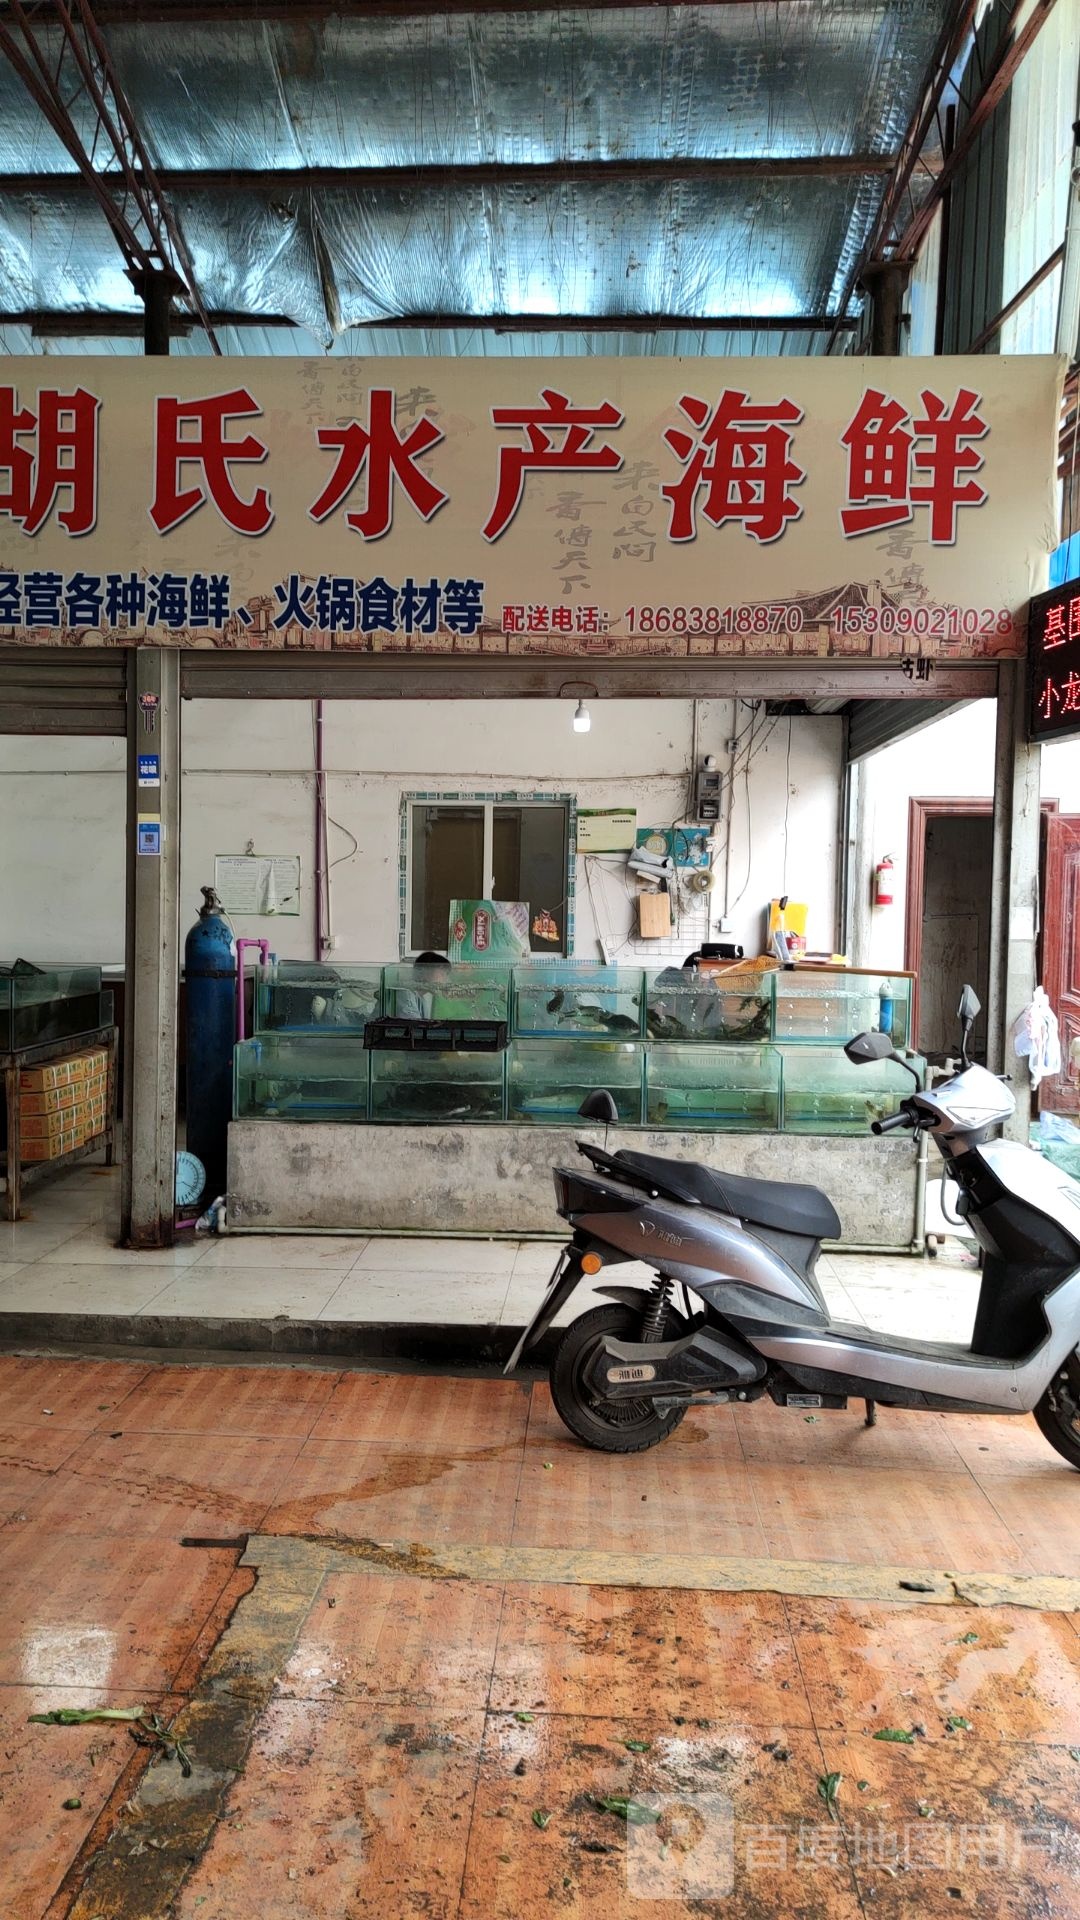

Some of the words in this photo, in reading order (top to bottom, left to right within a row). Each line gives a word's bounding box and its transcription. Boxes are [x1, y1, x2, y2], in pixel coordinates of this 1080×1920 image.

[0, 386, 989, 545] 胡氏水产海鲜
[624, 605, 805, 634] 18683818870
[831, 606, 1014, 635] 15309021028
